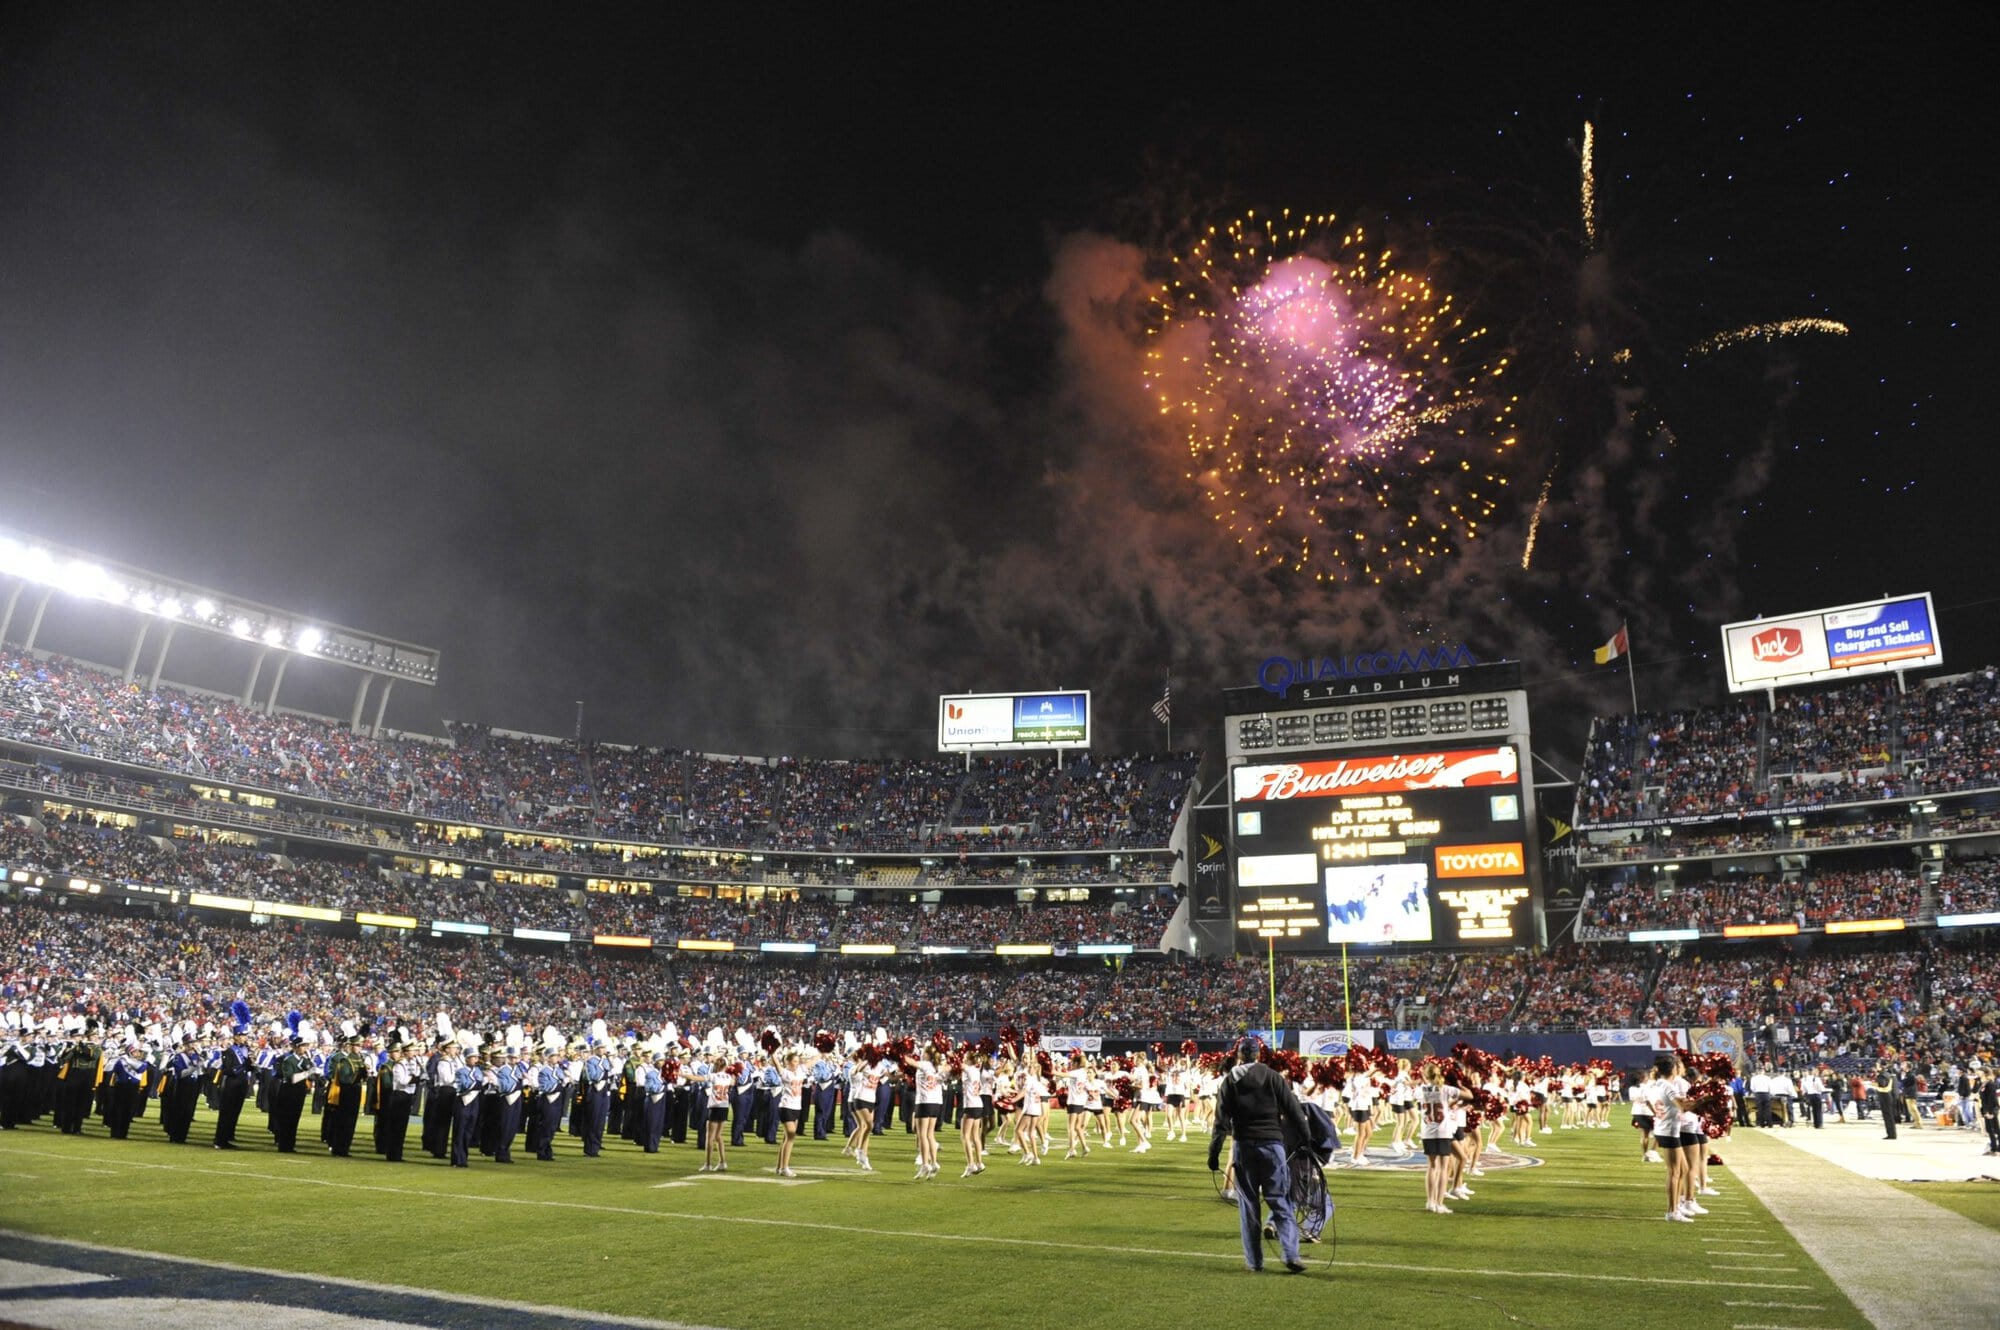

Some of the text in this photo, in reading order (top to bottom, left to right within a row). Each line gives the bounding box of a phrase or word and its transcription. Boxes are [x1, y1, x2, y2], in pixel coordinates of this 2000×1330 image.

[1845, 620, 1909, 640] Buy and Sell
[1754, 630, 1801, 661] Jack
[1834, 630, 1925, 653] Chargers Tickets!
[1257, 644, 1476, 699] QUALCOMM
[1303, 675, 1459, 698] STADIUM
[1262, 755, 1446, 800] Budweiser
[1386, 795, 1403, 807] TO
[1332, 808, 1413, 825] DR PEPPER
[1312, 820, 1441, 840] HALFTIME SHOW
[1440, 851, 1520, 871] TOYOTA
[1543, 845, 1577, 859] Sprint
[1197, 862, 1226, 875] Sprint
[1658, 1030, 1679, 1049] N
